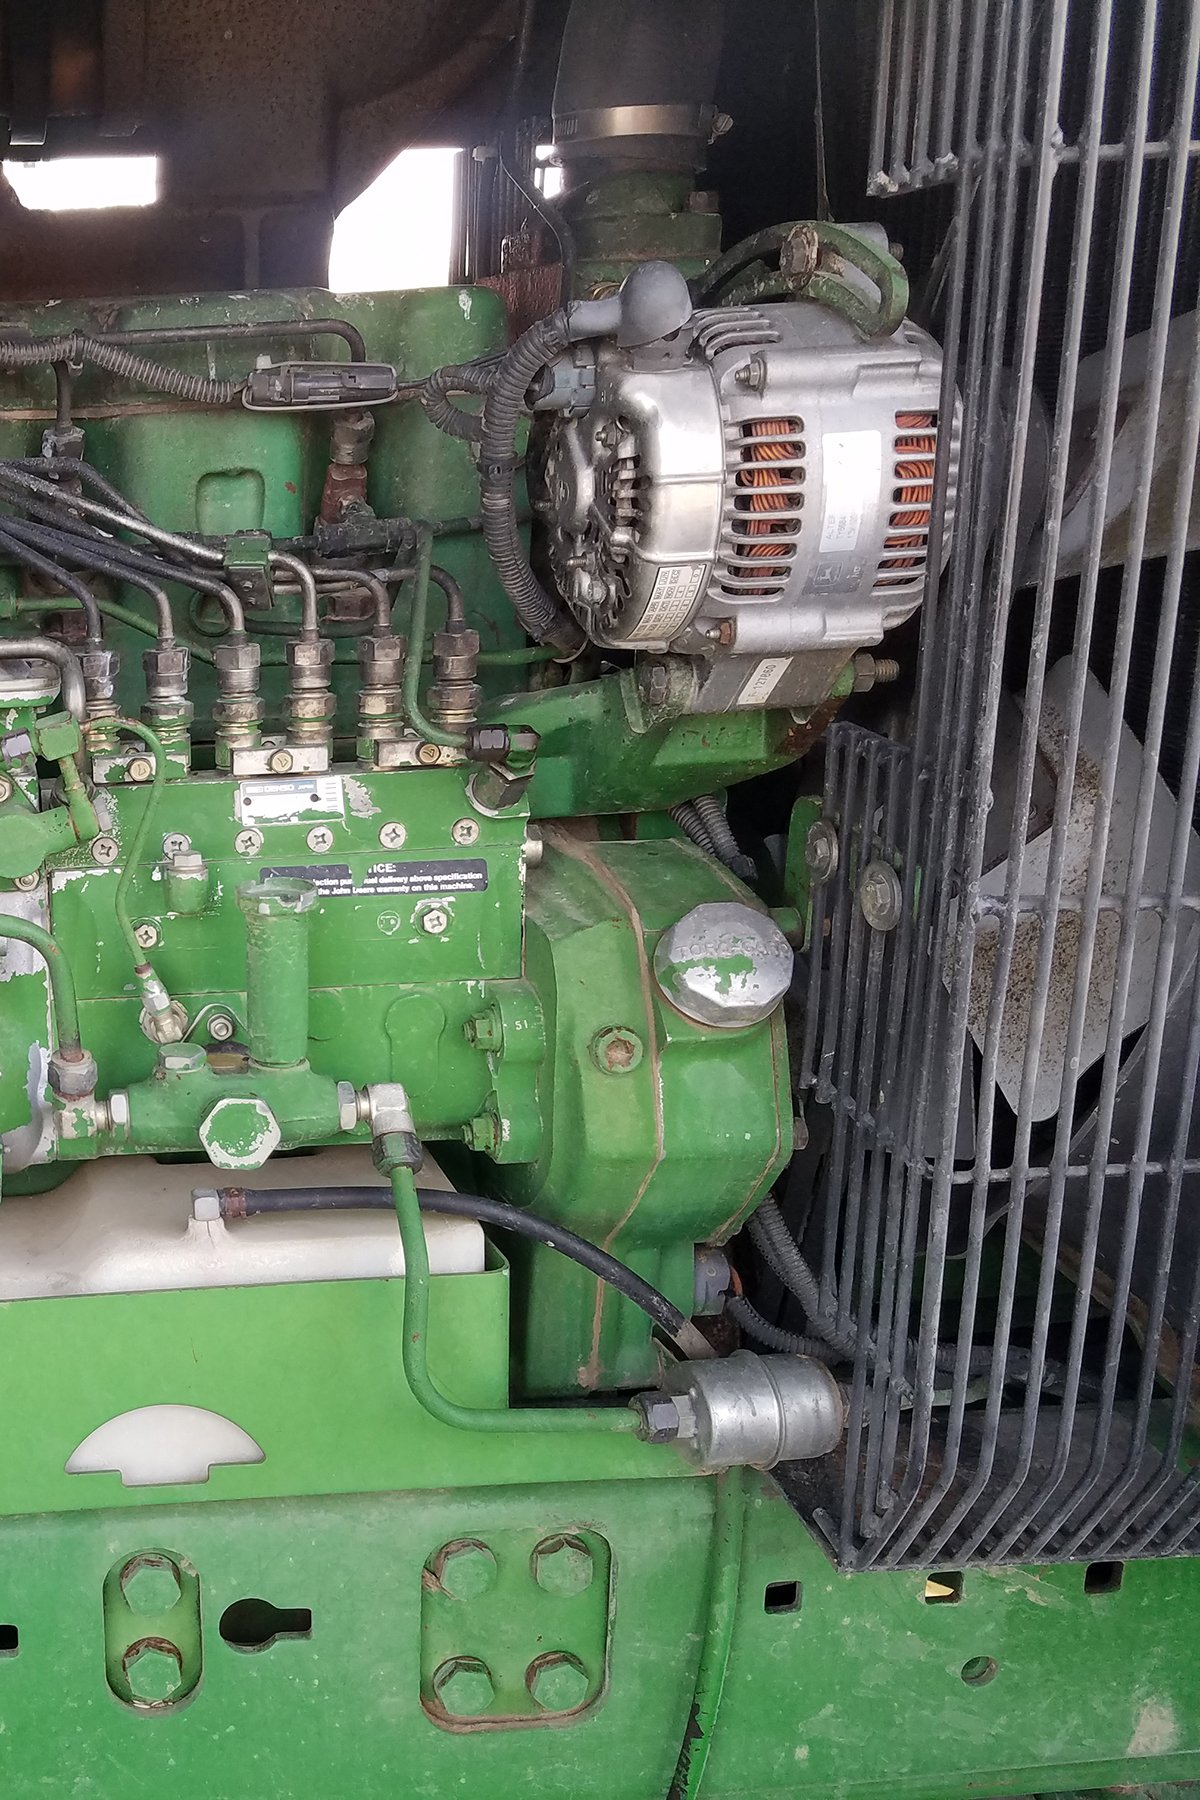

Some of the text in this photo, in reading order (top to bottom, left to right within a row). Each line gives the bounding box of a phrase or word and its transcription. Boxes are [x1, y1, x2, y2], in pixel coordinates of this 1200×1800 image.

[379, 874, 408, 885] delivery
[409, 873, 433, 883] above
[433, 871, 483, 883] specification
[331, 886, 351, 895] John
[376, 883, 410, 895] warranty
[411, 884, 422, 892] on
[422, 882, 439, 892] this
